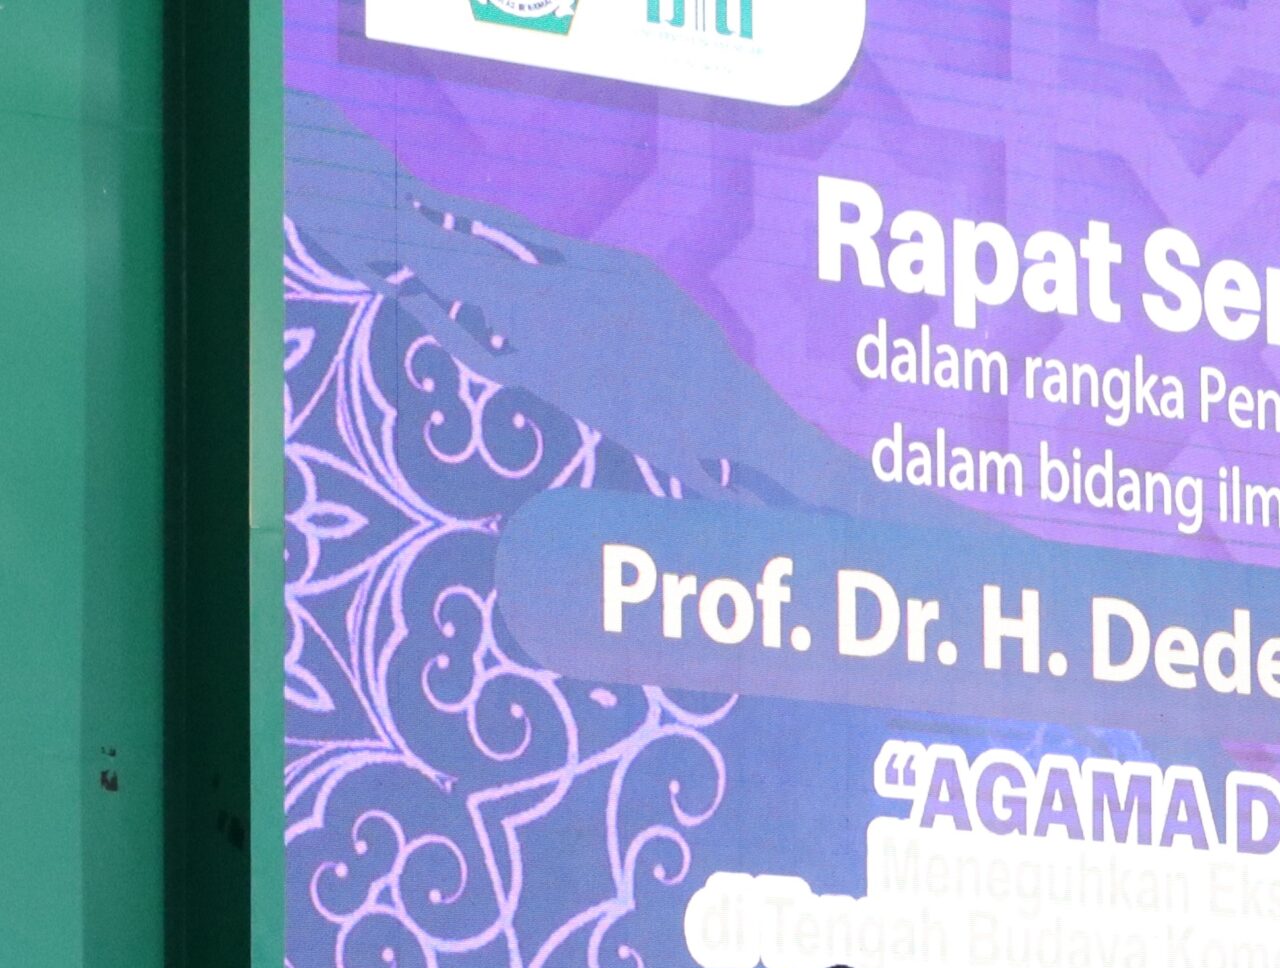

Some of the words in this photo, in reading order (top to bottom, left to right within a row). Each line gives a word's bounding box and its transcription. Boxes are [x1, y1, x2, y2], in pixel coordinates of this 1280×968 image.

[818, 175, 1121, 330] Rapat
[856, 318, 1008, 395] dalam
[1025, 354, 1185, 426] rangka
[872, 422, 1023, 497] dalam
[1040, 441, 1203, 534] bidang
[603, 544, 811, 651] Prof.
[838, 570, 957, 665] Dr.
[983, 585, 1068, 676] H.
[884, 751, 1211, 850] “AGAMA
[700, 889, 744, 953] di
[880, 836, 1190, 919] Meneguhkan
